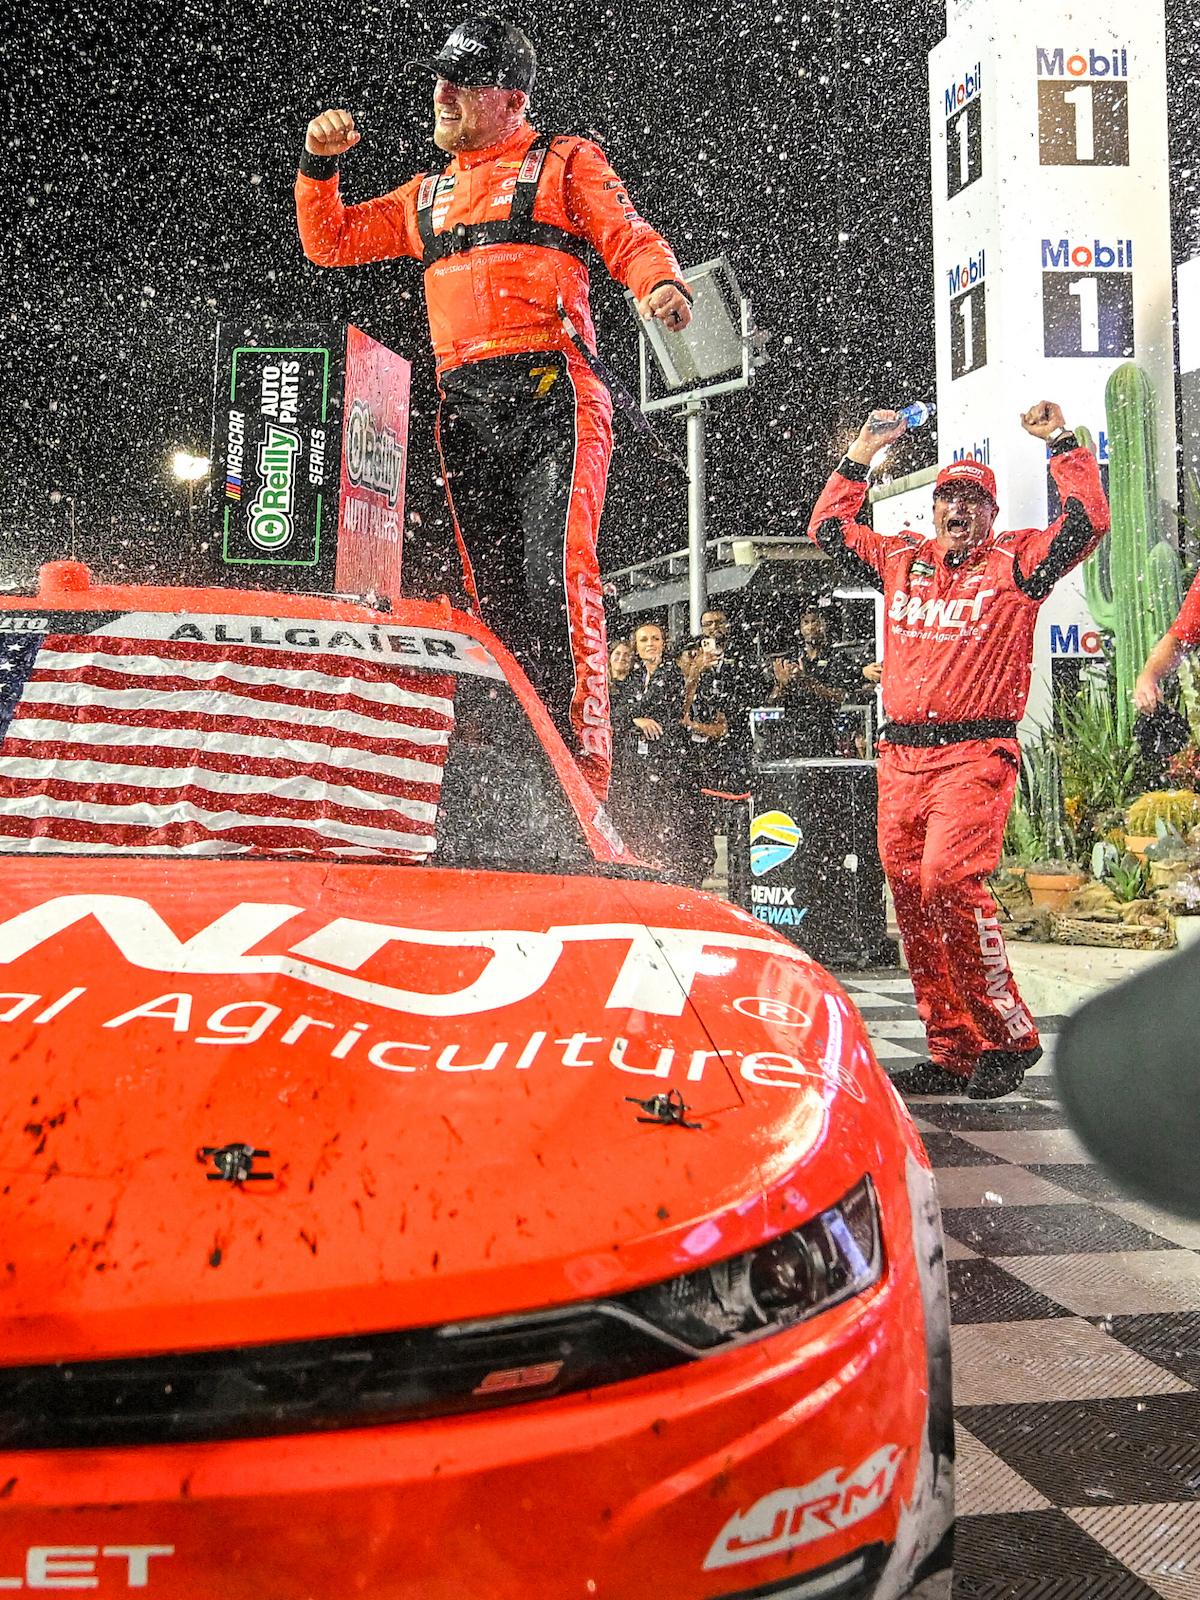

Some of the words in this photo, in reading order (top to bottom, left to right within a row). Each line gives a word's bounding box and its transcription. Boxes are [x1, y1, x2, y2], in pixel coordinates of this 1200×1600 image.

[945, 61, 981, 116] Mobil
[1036, 48, 1128, 76] Mobil
[955, 111, 969, 185] 1
[1064, 86, 1094, 160] 1
[949, 249, 985, 296] Mobil
[1041, 239, 1132, 268] Mobil
[959, 295, 973, 371] 1
[1069, 277, 1099, 352] 1
[261, 365, 282, 416] AUTO
[279, 361, 300, 424] PARTS
[529, 365, 558, 400] 7
[226, 410, 246, 478] NASCAR
[309, 427, 326, 486] SERIES
[250, 428, 298, 548] O'Reilly
[344, 496, 369, 535] AUTO
[169, 622, 462, 661] ALLGAIER
[577, 572, 612, 755] BRANDT
[974, 908, 1033, 1039] BRANDT
[102, 992, 806, 1089] Agriculture
[722, 1464, 892, 1553] JRM
